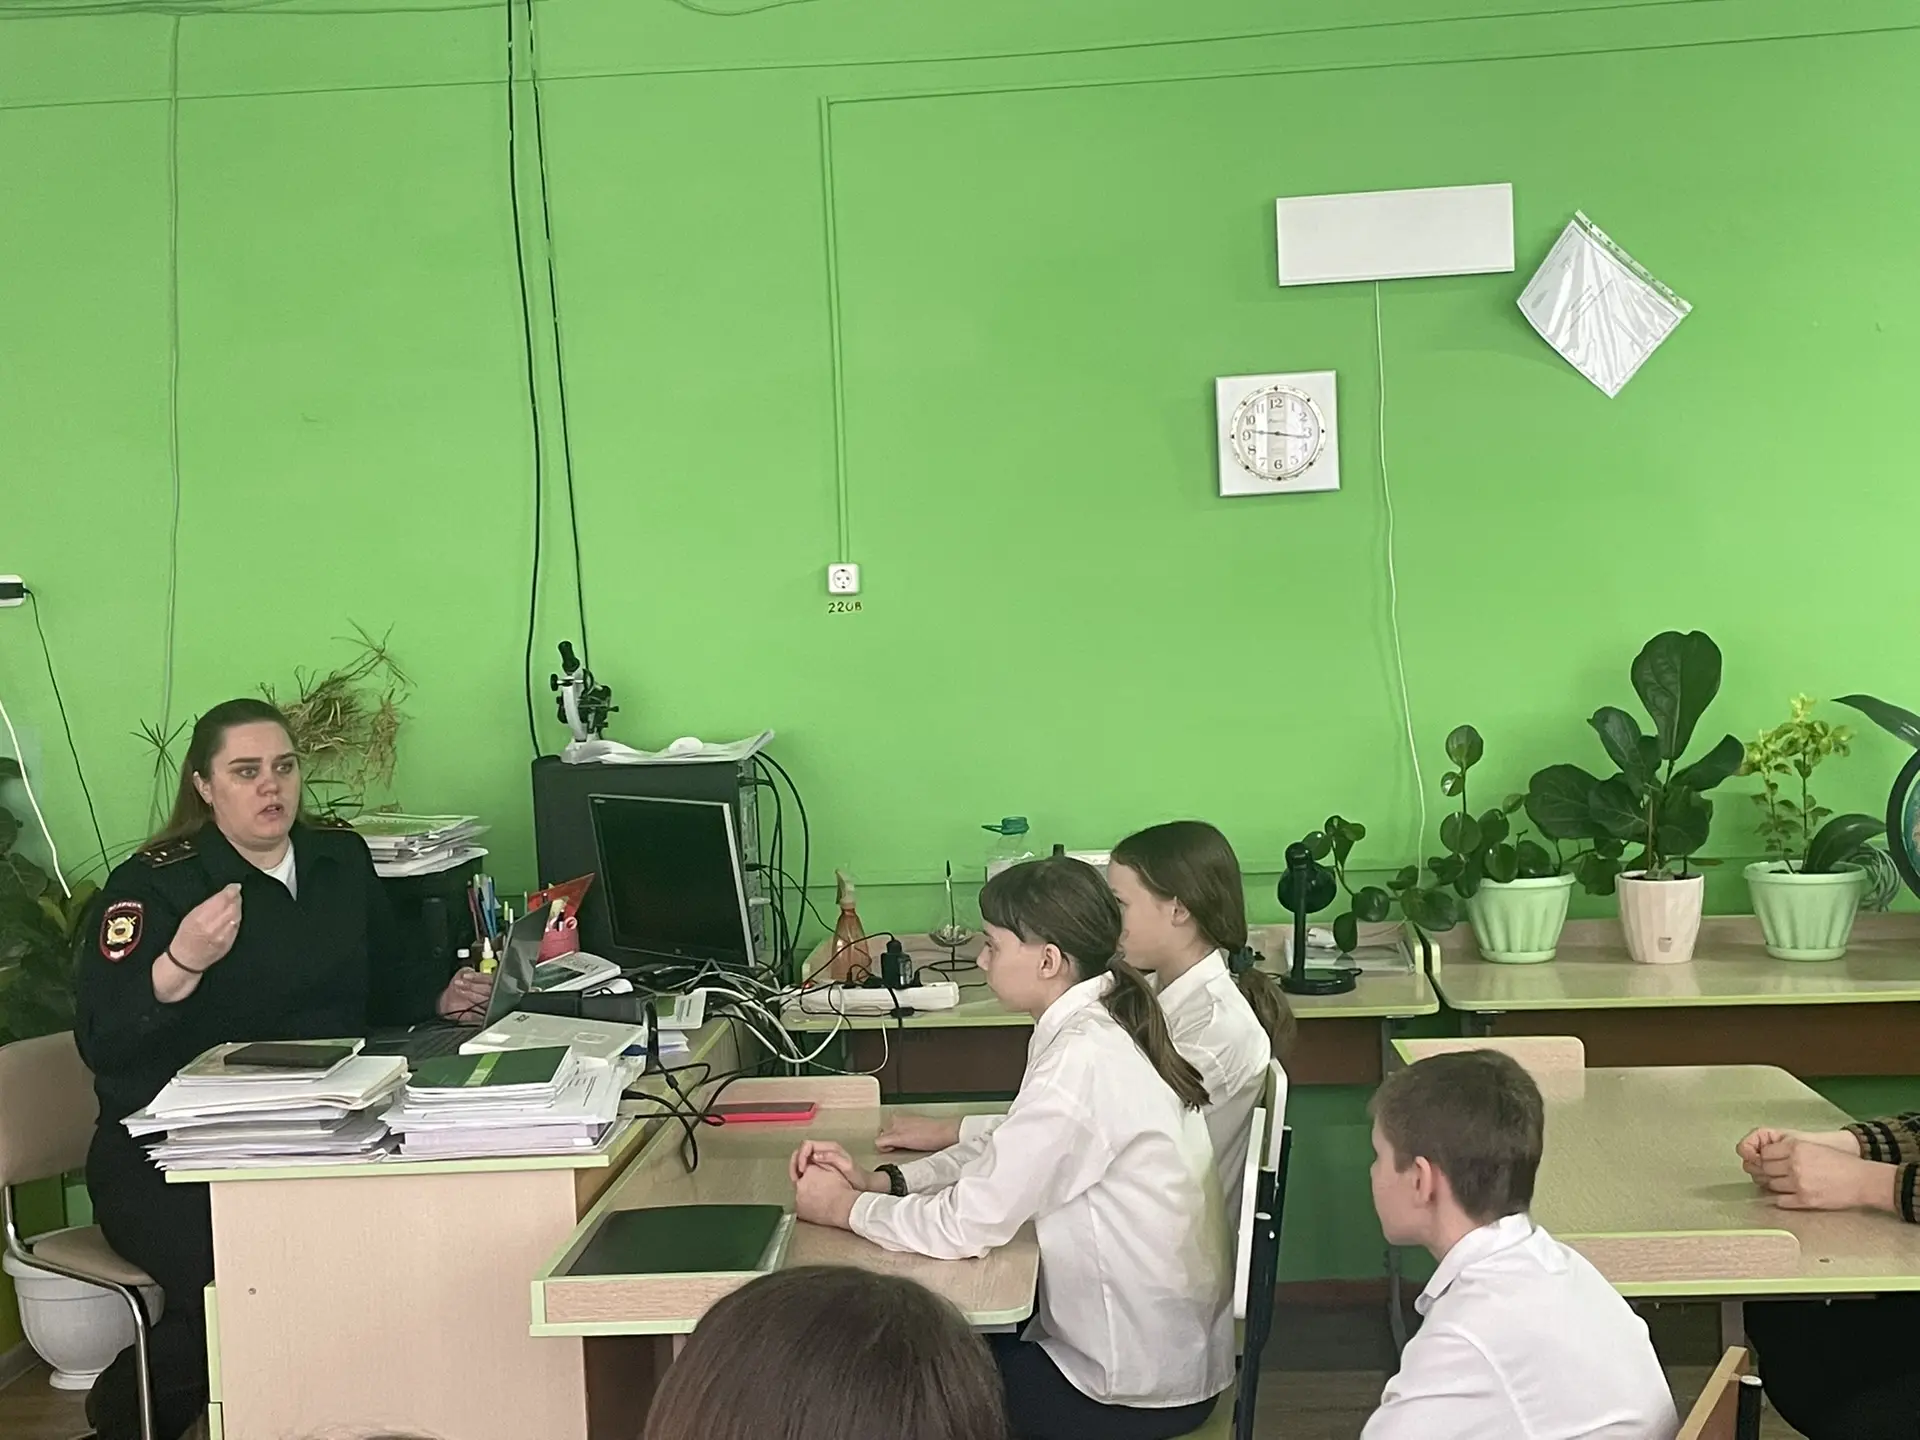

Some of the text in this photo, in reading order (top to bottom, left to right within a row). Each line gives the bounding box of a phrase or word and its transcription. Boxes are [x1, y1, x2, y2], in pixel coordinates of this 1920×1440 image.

[1256, 403, 1265, 414] 11
[1270, 398, 1283, 409] 12
[1291, 402, 1296, 412] 1
[1245, 415, 1256, 425] 10
[1299, 412, 1308, 421] 2
[1242, 431, 1251, 441] 9
[1303, 427, 1312, 438] 3
[1248, 445, 1257, 455] 8
[1299, 443, 1308, 452] 4
[1259, 457, 1266, 467] 7
[1274, 459, 1283, 469] 6
[1290, 455, 1299, 465] 5
